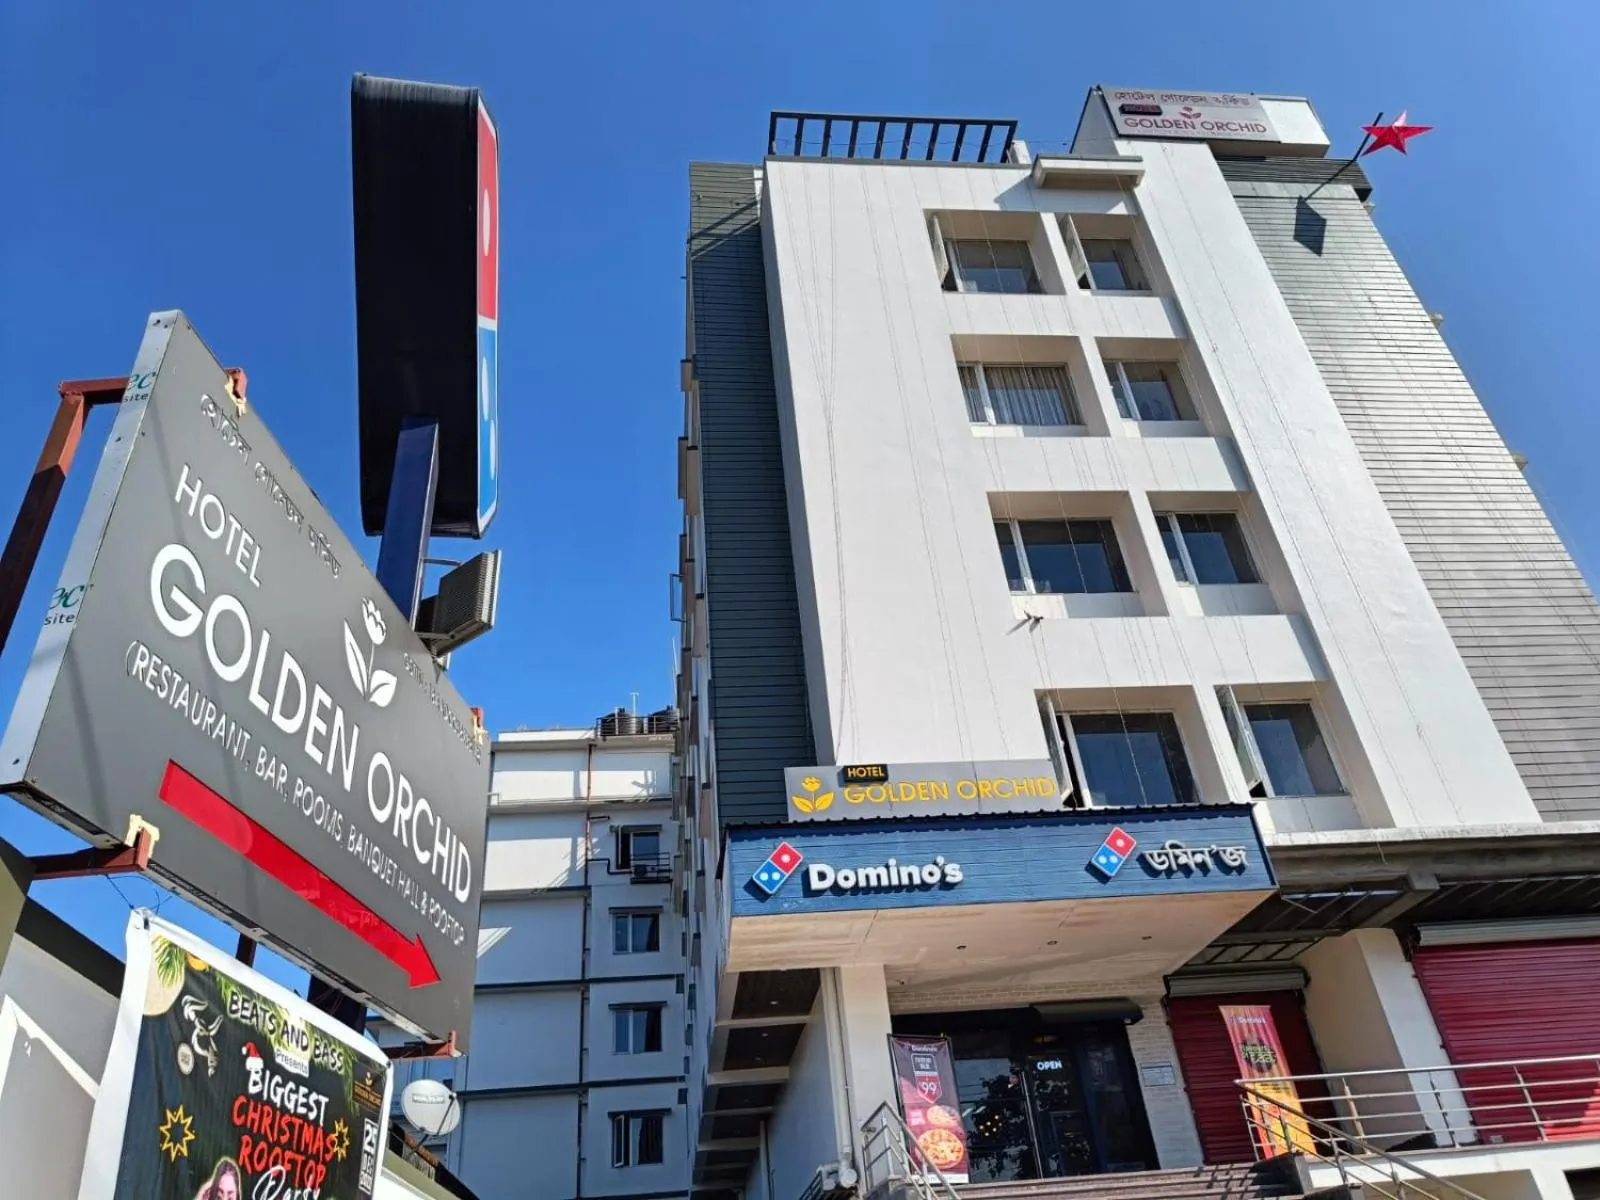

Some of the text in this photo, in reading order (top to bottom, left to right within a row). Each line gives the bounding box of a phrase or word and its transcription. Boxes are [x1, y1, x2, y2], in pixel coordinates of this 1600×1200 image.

[1124, 117, 1196, 131] GOLDEN
[1201, 120, 1267, 134] ORCHID
[174, 462, 262, 589] HOTEL
[150, 543, 360, 793] GOLDEN
[367, 750, 472, 904] ORCHID
[843, 776, 1056, 805] GOLDEN ORCHID
[847, 766, 884, 778] HOTEL
[347, 823, 398, 888] BANQUET
[397, 869, 419, 909] HALL
[421, 890, 428, 915] &
[428, 897, 465, 945] ROOFTOP
[808, 855, 964, 892] Domino's
[228, 989, 345, 1072] BEATS AND BASS
[275, 1048, 309, 1075] Presents
[1036, 1060, 1063, 1071] OPEN
[248, 1067, 330, 1127] BIGGEST
[231, 1094, 338, 1162] CHRISTMAS
[239, 1134, 327, 1190] ROOFTOP
